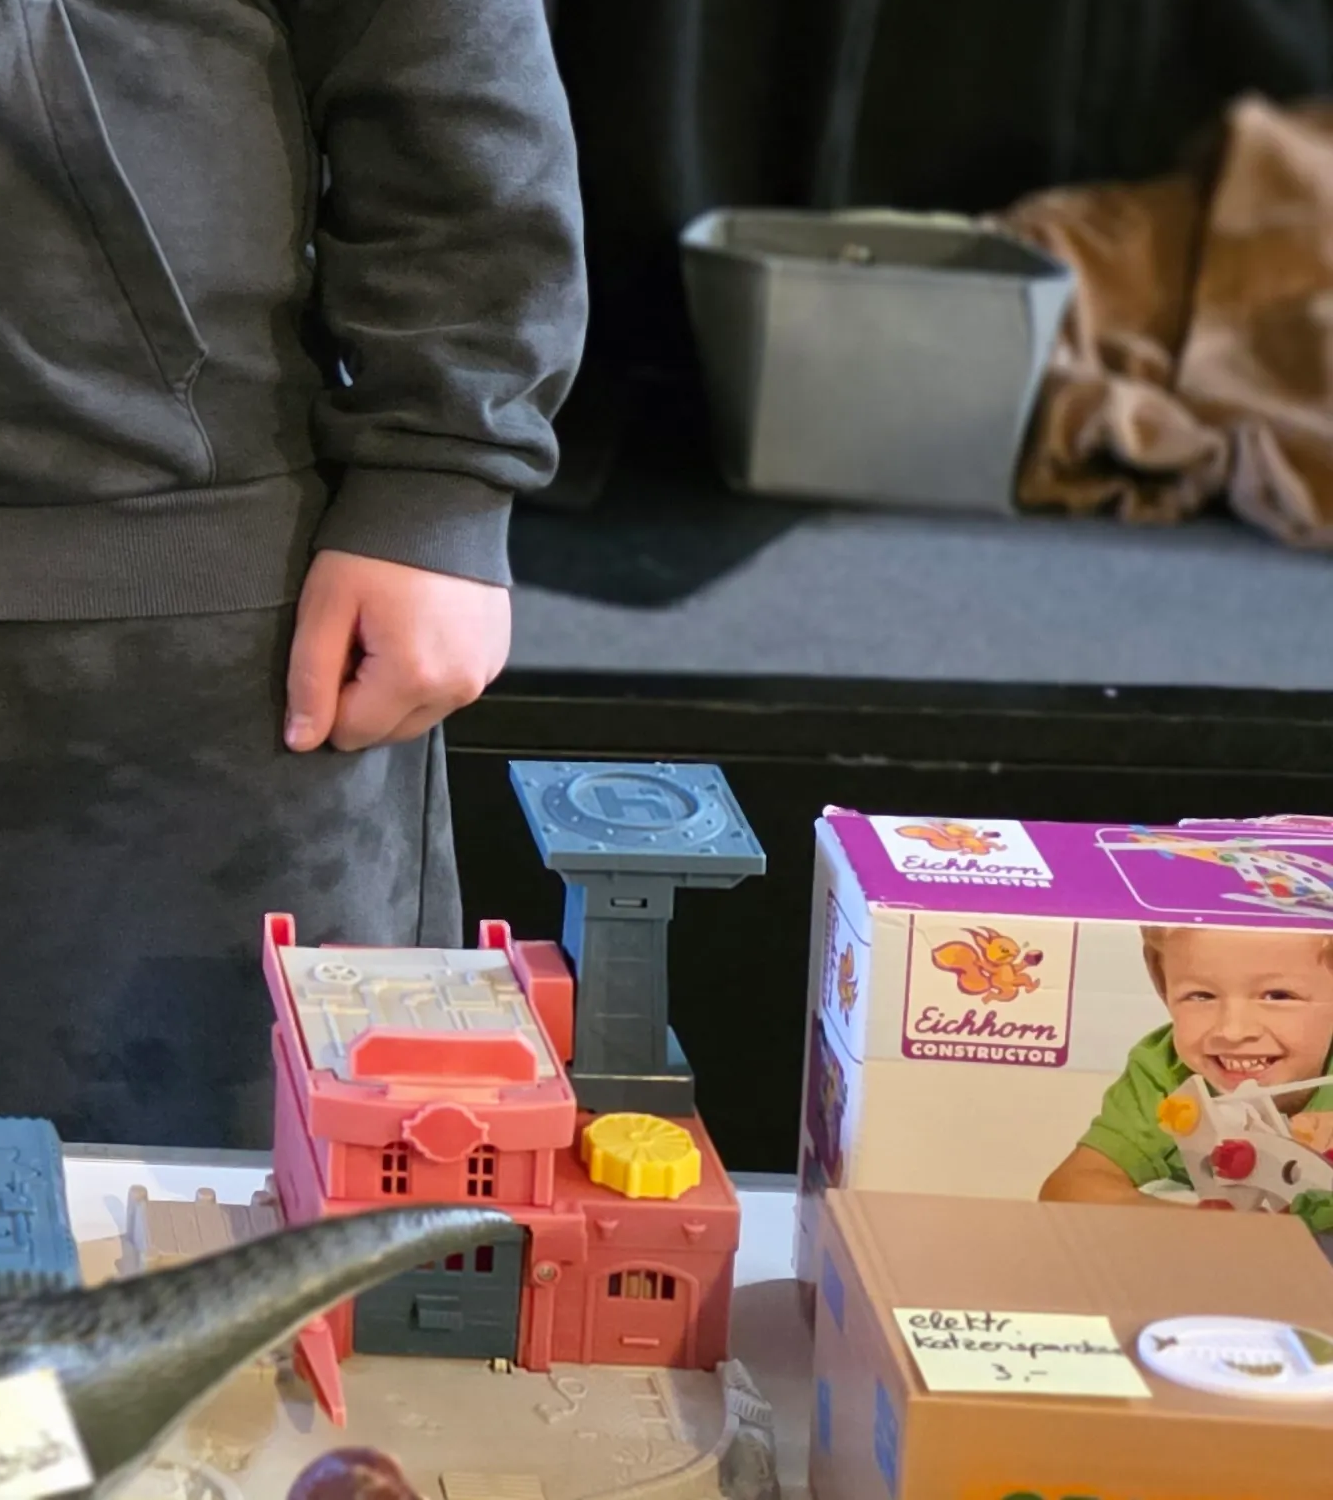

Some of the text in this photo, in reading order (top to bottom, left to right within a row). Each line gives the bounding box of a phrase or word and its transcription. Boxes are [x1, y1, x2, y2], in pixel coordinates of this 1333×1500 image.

[902, 855, 1044, 877] Eichhorn
[906, 873, 1052, 888] CONSTRUCTOR
[914, 1006, 1058, 1040] Eichhorn
[911, 1042, 1057, 1064] CONSTRUCTOR
